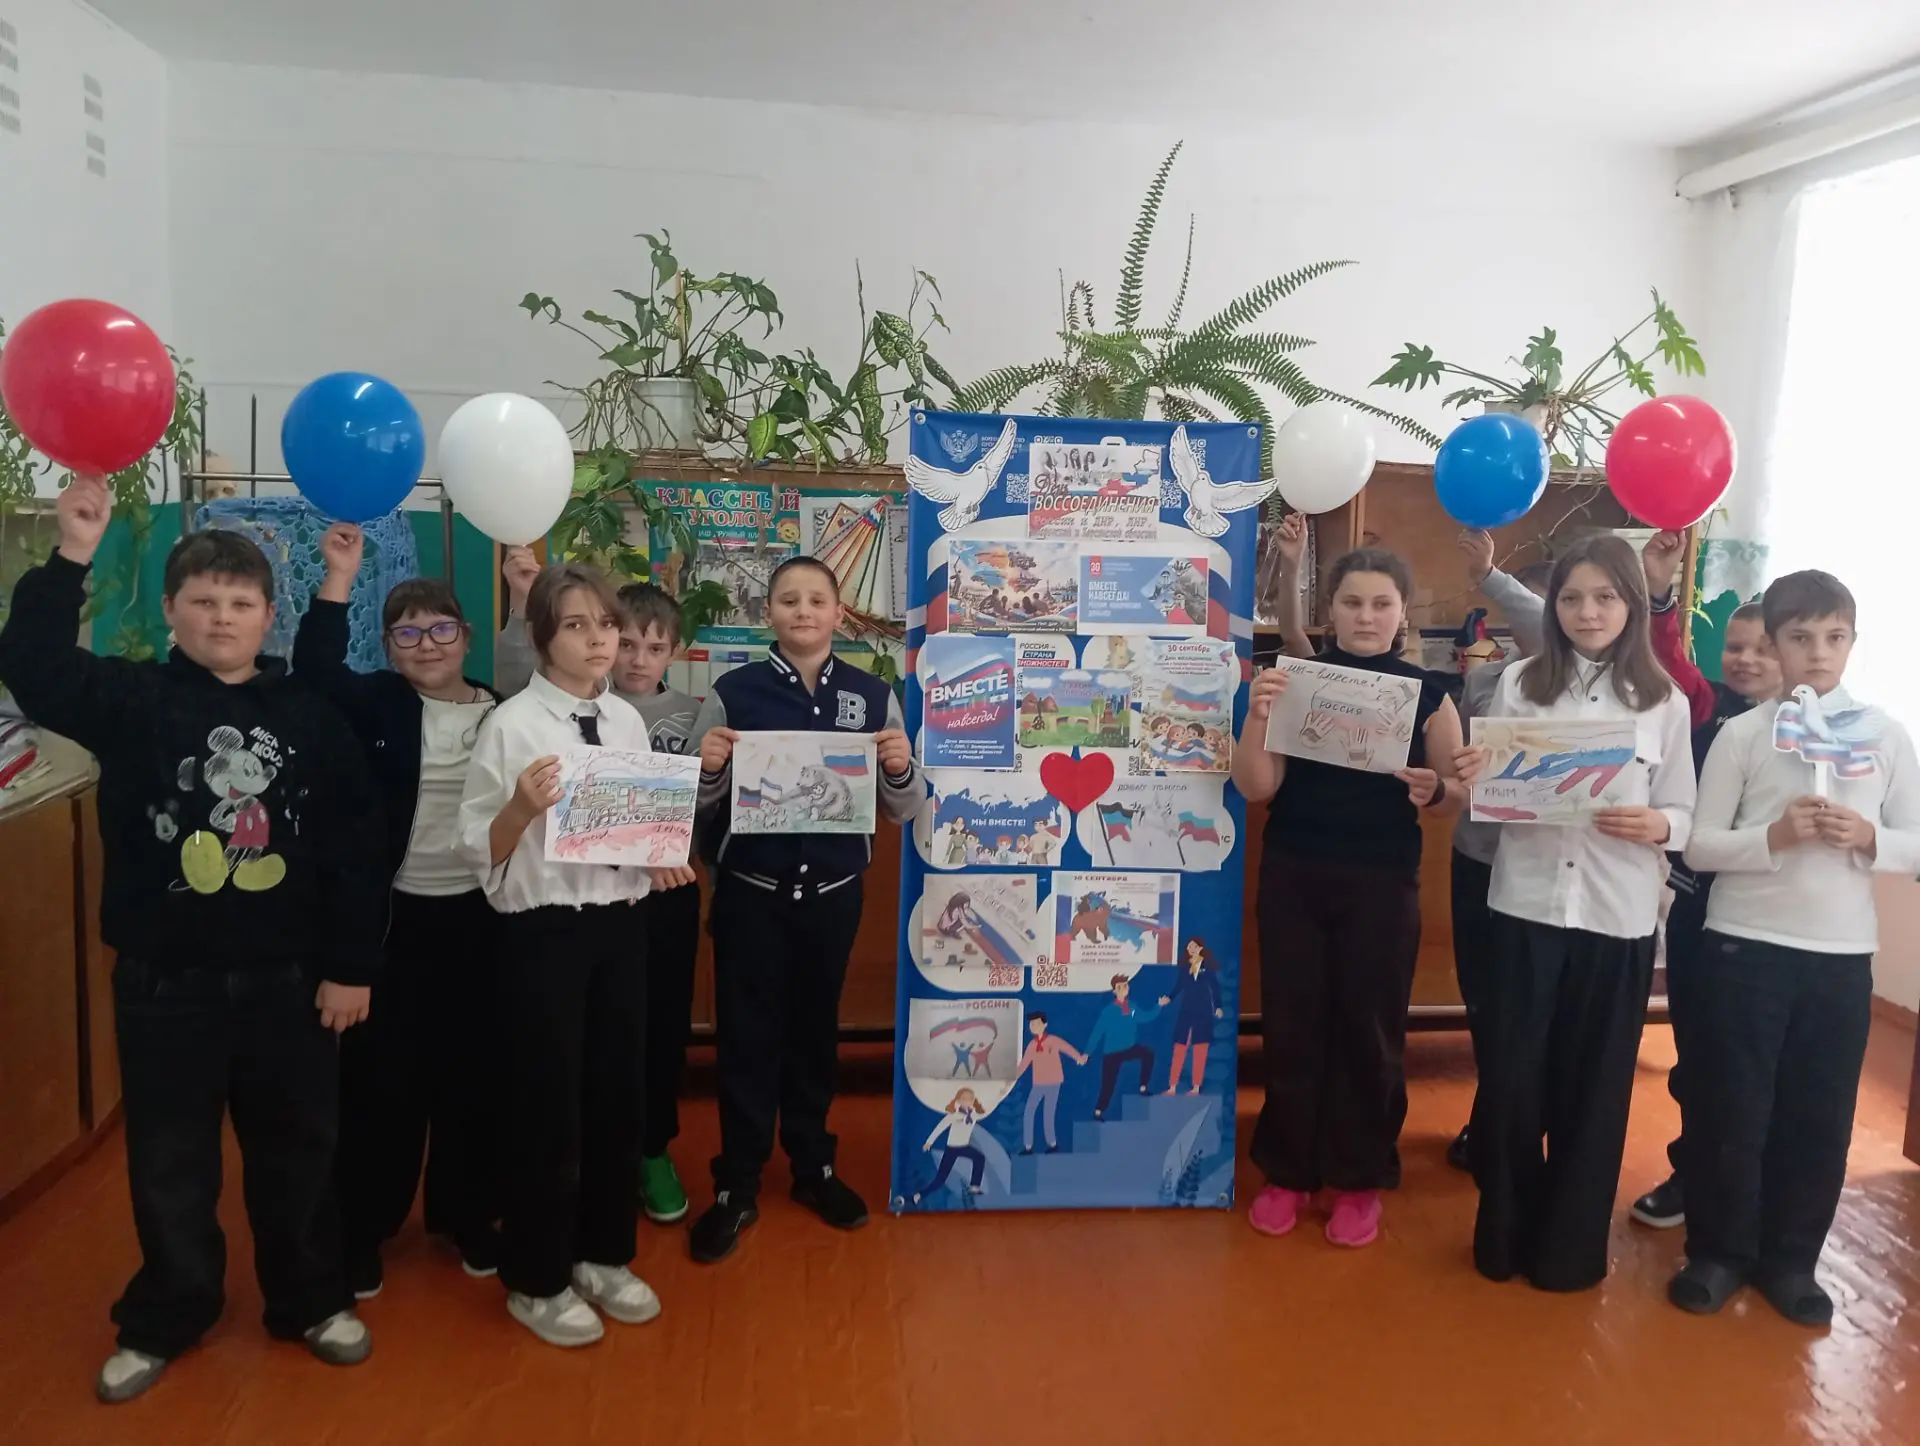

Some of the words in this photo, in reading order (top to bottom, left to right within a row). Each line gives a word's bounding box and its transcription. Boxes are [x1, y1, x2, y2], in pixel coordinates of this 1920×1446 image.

[1034, 495, 1157, 516] ВОССОЕДИНЕНИЯ
[688, 509, 776, 529] УГОЛОК
[1020, 642, 1049, 650] РОССИЯ
[1024, 651, 1054, 659] СТРАНА
[931, 673, 1009, 704] ВМЕСТЕ
[947, 705, 1001, 730] навсегда!
[1484, 786, 1517, 799] КРЫМ
[971, 818, 987, 827] МЫ
[988, 818, 1027, 827] ВМЕСТЕ!
